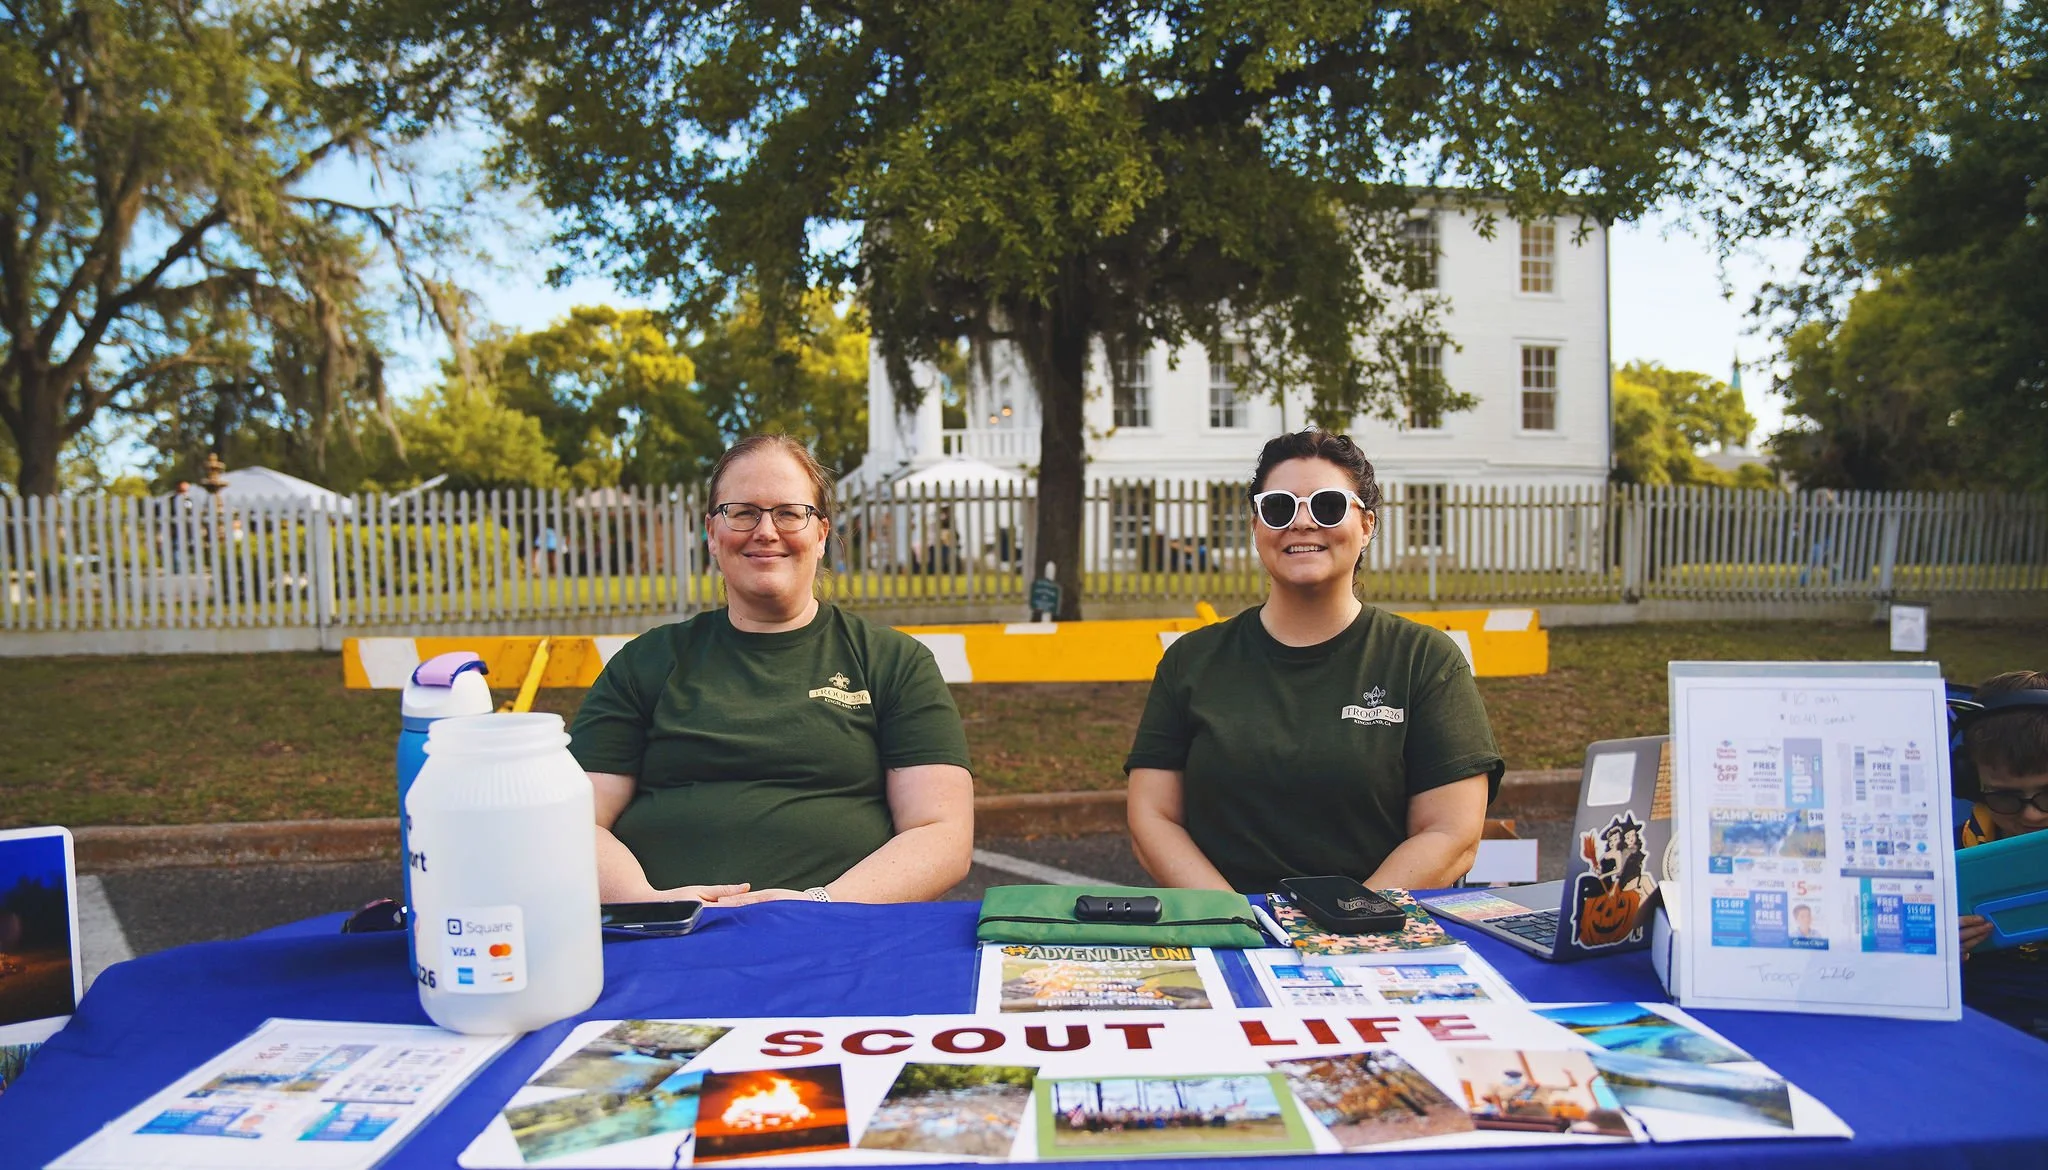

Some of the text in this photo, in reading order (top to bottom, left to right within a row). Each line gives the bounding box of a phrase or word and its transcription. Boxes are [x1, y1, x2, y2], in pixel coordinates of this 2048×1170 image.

[814, 688, 848, 701] TROOP
[1346, 707, 1400, 721] TROOP 226
[1753, 762, 1776, 770] FREE
[1872, 762, 1891, 770] FREE
[1717, 773, 1737, 782] OFF
[1712, 809, 1787, 821] CAMP CARD
[1755, 893, 1783, 904] FREE
[1877, 896, 1898, 907] FREE
[1731, 900, 1744, 909] OFF
[1919, 905, 1930, 914] OFF
[1755, 910, 1783, 921] FREE
[466, 921, 513, 936] Square
[452, 946, 477, 957] VISA
[1745, 963, 1856, 988] Troop 226
[1036, 998, 1174, 1007] Episcopal Church
[760, 1016, 1493, 1057] SCOUT LIFE
